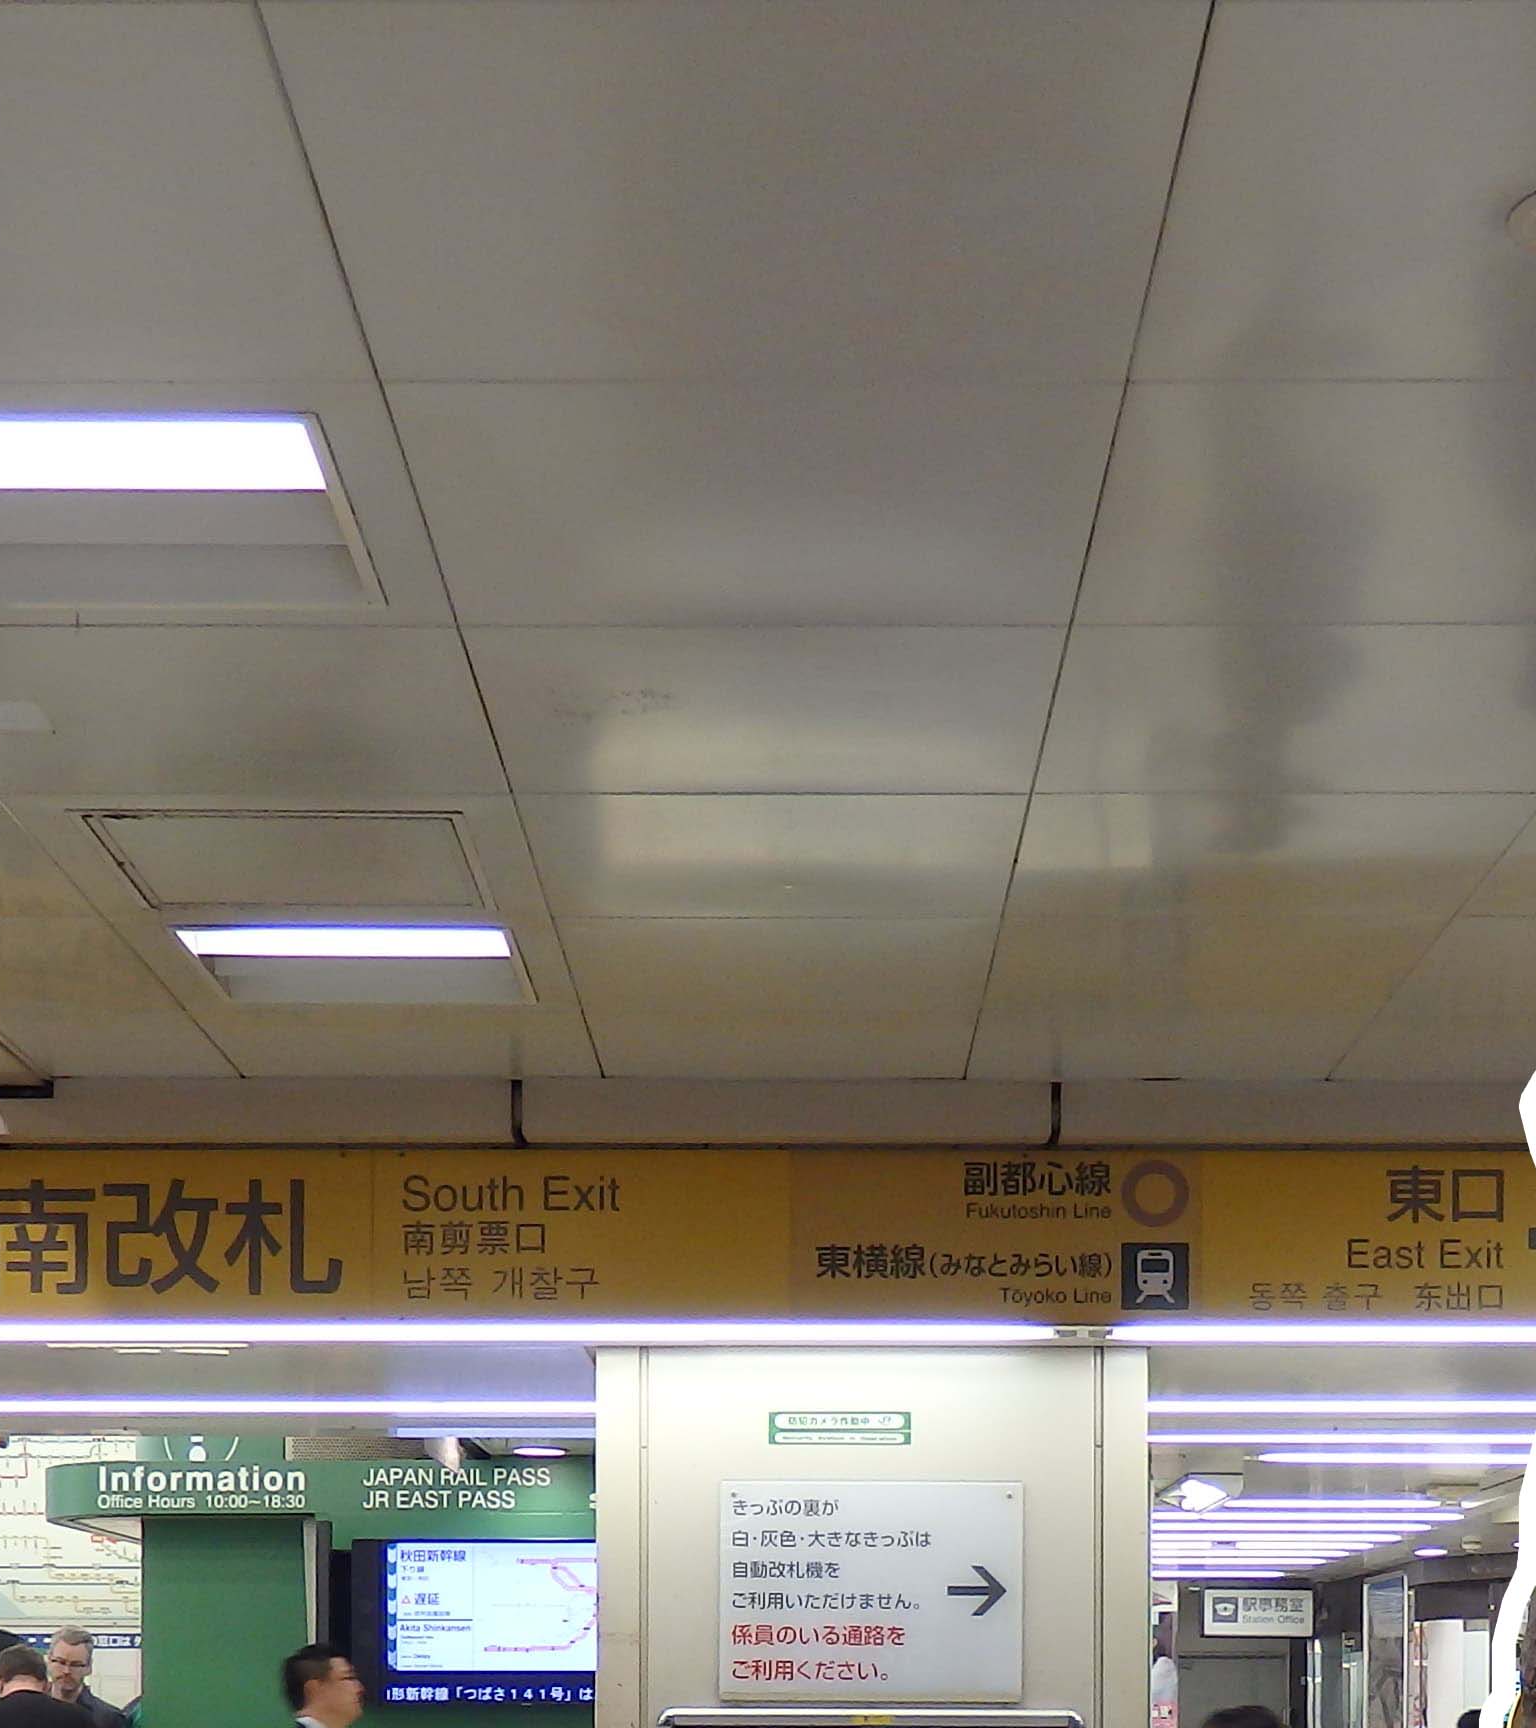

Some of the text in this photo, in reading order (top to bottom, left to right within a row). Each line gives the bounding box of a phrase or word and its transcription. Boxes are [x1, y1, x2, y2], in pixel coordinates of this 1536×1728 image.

[964, 1161, 1112, 1198] 副都心線
[402, 1175, 621, 1213] South Exit
[1387, 1167, 1504, 1224] 東口
[966, 1203, 1112, 1221] Fukutoshin Line
[402, 1221, 546, 1256] 南剪票口
[815, 1244, 1113, 1280] 東横線(みなとみらい線)
[1348, 1239, 1504, 1272] East Exit
[402, 1267, 601, 1301] 남쪽 개찰구
[1073, 1287, 1112, 1306] Line
[1251, 1282, 1384, 1311] 동쪽 출구
[1414, 1281, 1504, 1311] 东出口
[97, 1467, 307, 1492] Information
[363, 1468, 550, 1487] JAPAN RAIL PASS
[97, 1494, 142, 1508] Office
[148, 1495, 195, 1508] Hours
[363, 1491, 515, 1509] JR EAST PASS
[732, 1499, 839, 1518] きっぷの裏が
[732, 1530, 932, 1548] 白・灰色・大きなきっぷは
[400, 1549, 467, 1562] 秋田新幹線
[732, 1560, 841, 1580] 自動改札機を
[732, 1592, 922, 1611] ご利用いただけません。
[731, 1625, 906, 1647] 係員のいる通路を
[731, 1659, 890, 1681] ご利用ください。
